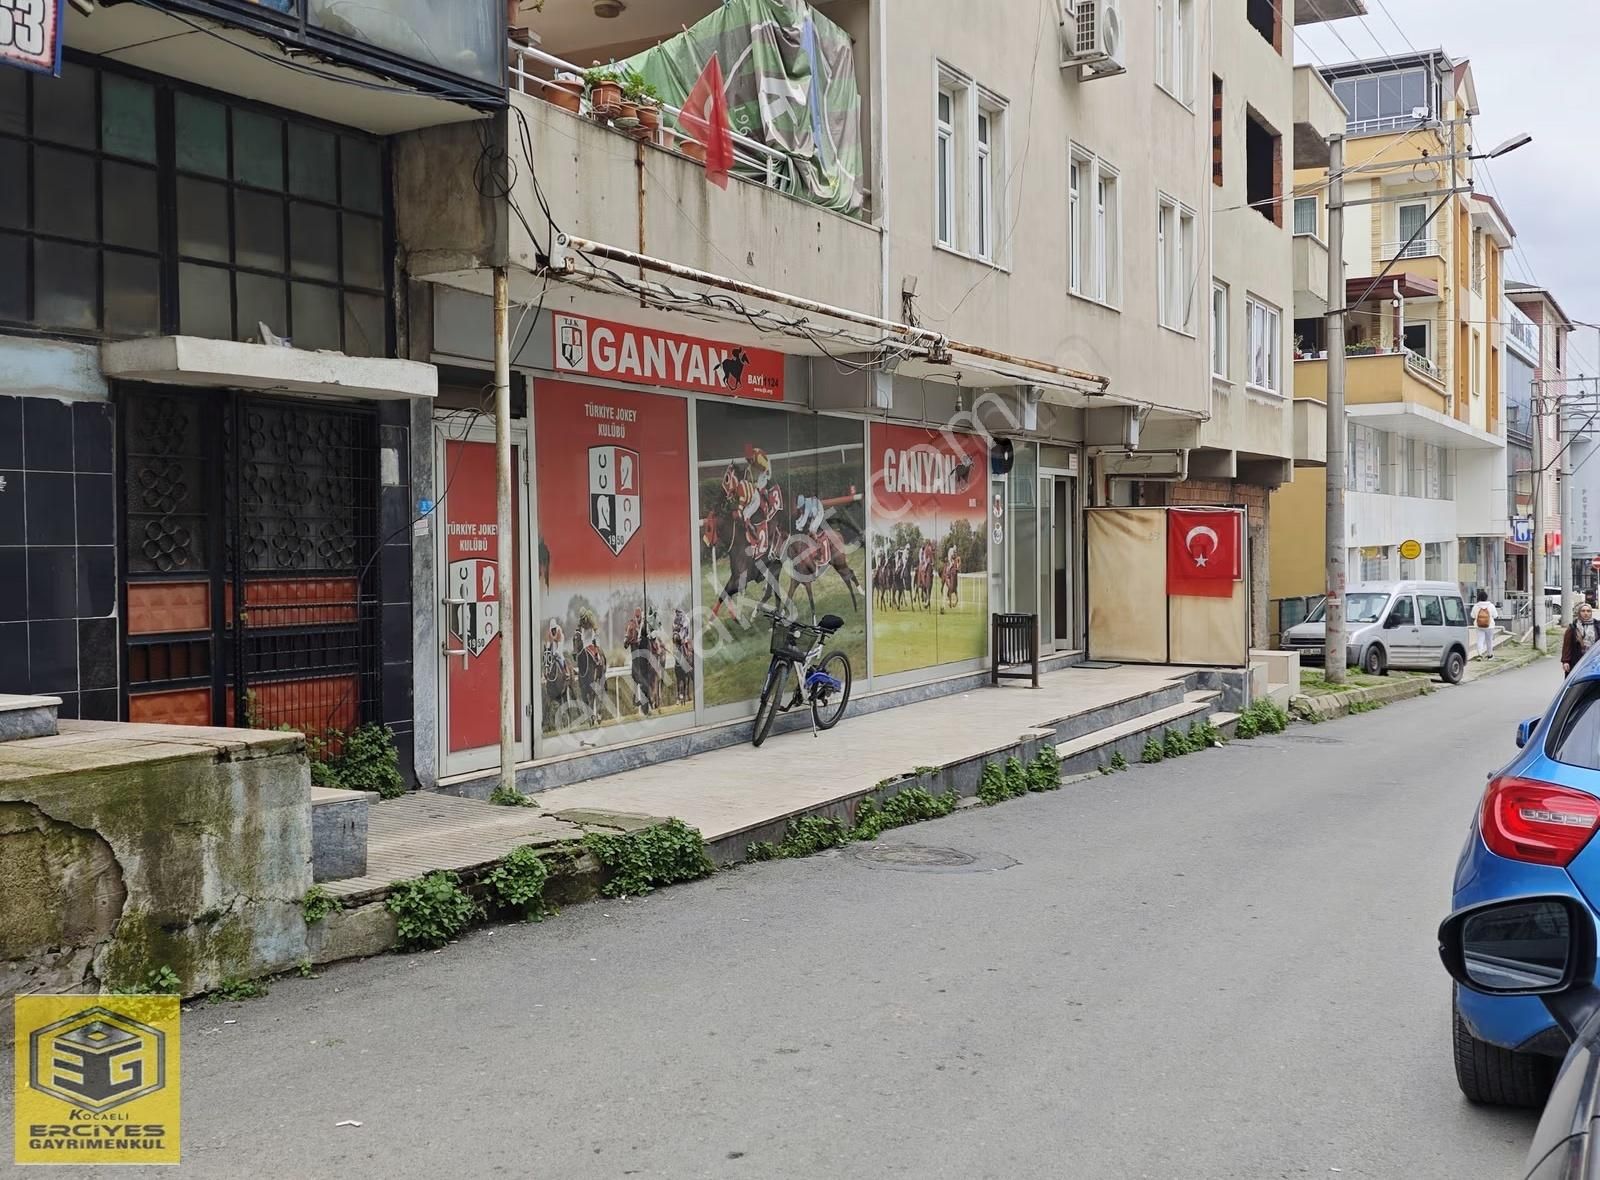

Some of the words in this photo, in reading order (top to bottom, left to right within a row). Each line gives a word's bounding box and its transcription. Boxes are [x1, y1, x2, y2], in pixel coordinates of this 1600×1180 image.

[591, 327, 728, 388] GANYAN
[584, 402, 614, 420] TÜRKİYE
[616, 408, 637, 422] JOKEY
[598, 423, 625, 438] KULÜBÜ
[884, 448, 956, 495] GANYAN
[447, 521, 477, 535] TÜRKİYE
[459, 537, 488, 551] KULÜBÜ
[608, 535, 624, 546] 1950
